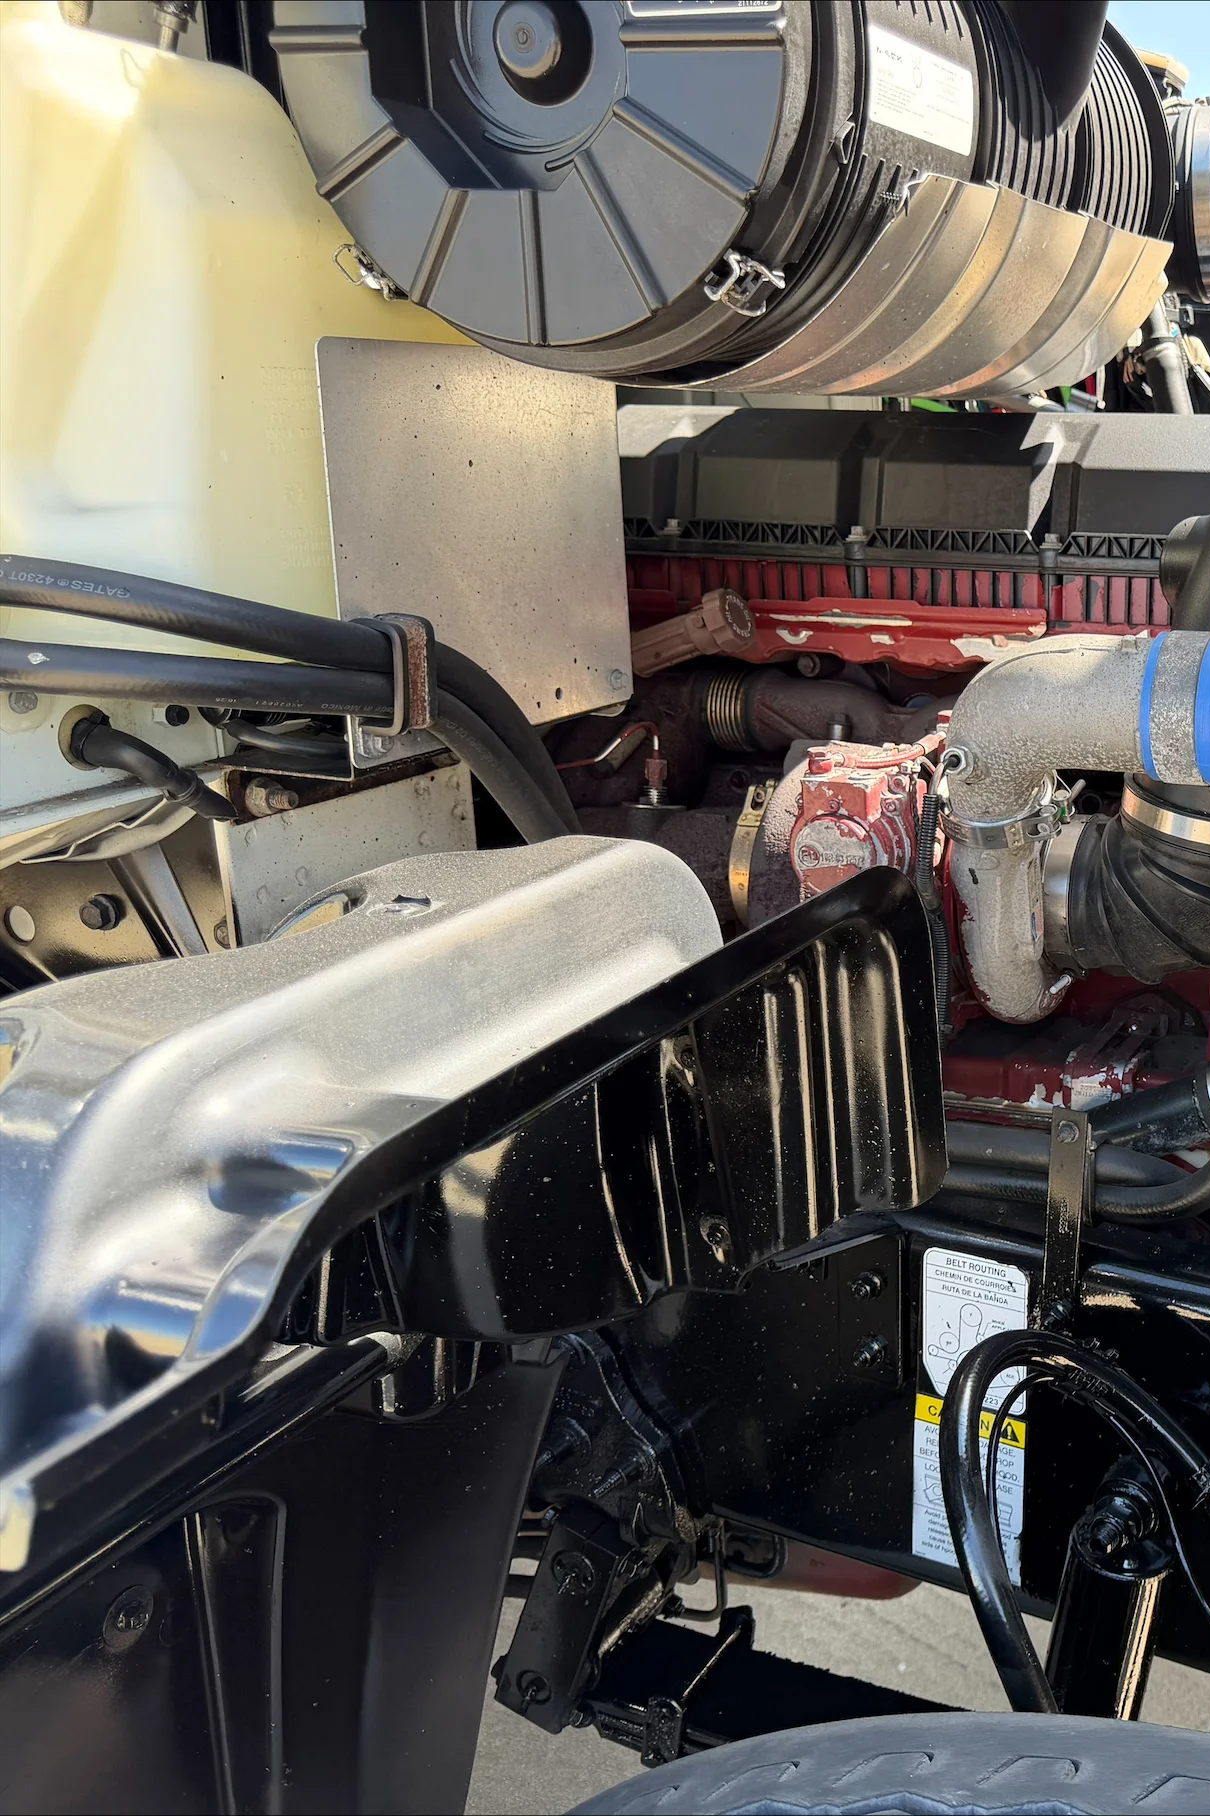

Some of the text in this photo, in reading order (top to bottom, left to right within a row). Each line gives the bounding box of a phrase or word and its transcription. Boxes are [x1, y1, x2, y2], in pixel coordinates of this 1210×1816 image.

[8, 571, 55, 586] 4230T
[946, 1257, 1007, 1278] BELT ROUTING
[935, 1269, 962, 1282] CHEMIN
[964, 1275, 973, 1284] DE
[942, 1284, 960, 1293] RUTA
[962, 1288, 972, 1297] DE
[973, 1291, 983, 1299] LA
